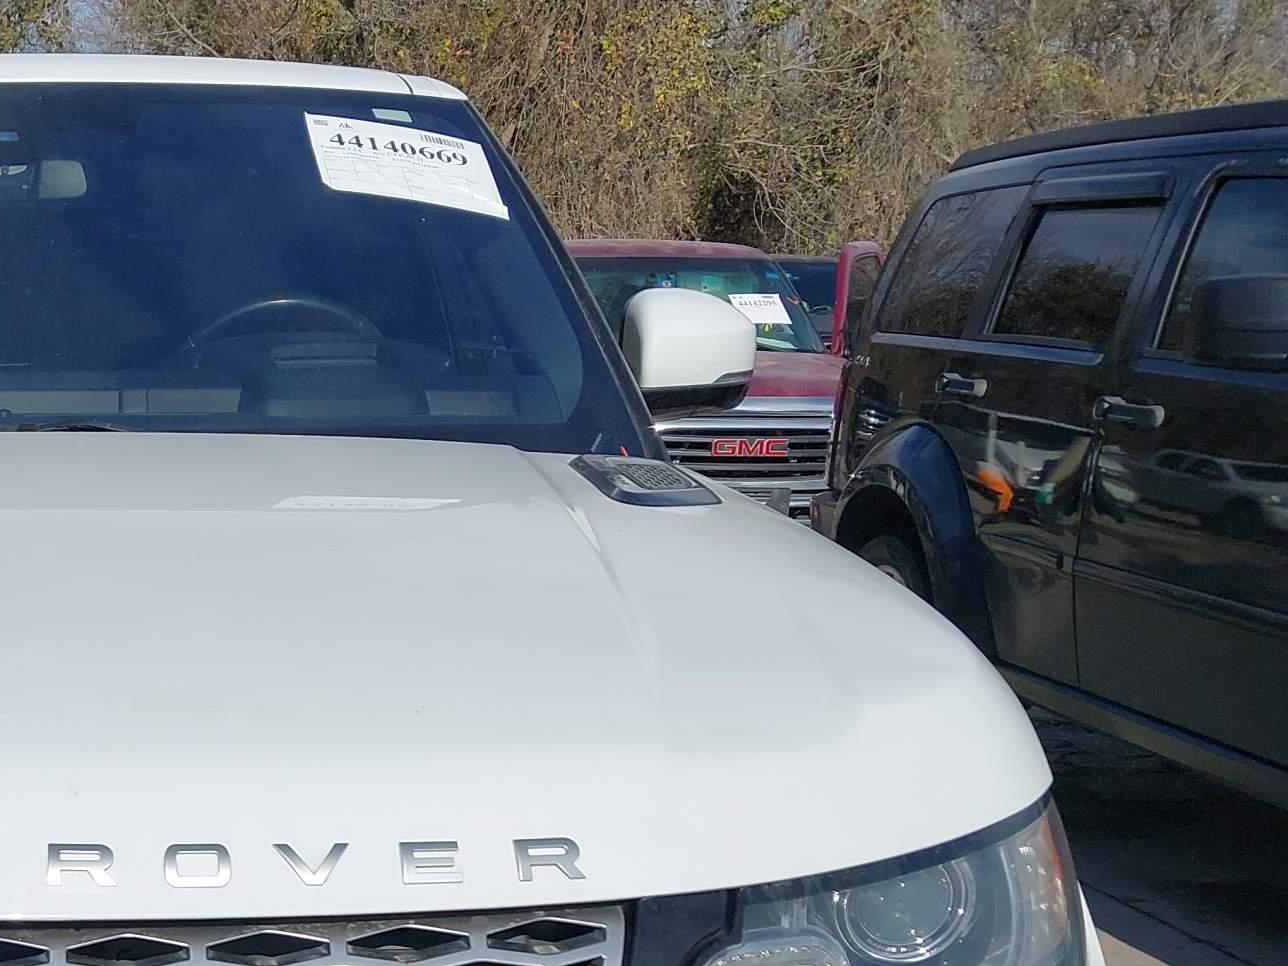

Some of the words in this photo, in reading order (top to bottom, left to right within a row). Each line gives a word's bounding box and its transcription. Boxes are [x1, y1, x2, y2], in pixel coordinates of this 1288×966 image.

[329, 131, 469, 166] 44140669
[712, 438, 790, 458] GMC
[45, 836, 587, 889] ROVER
